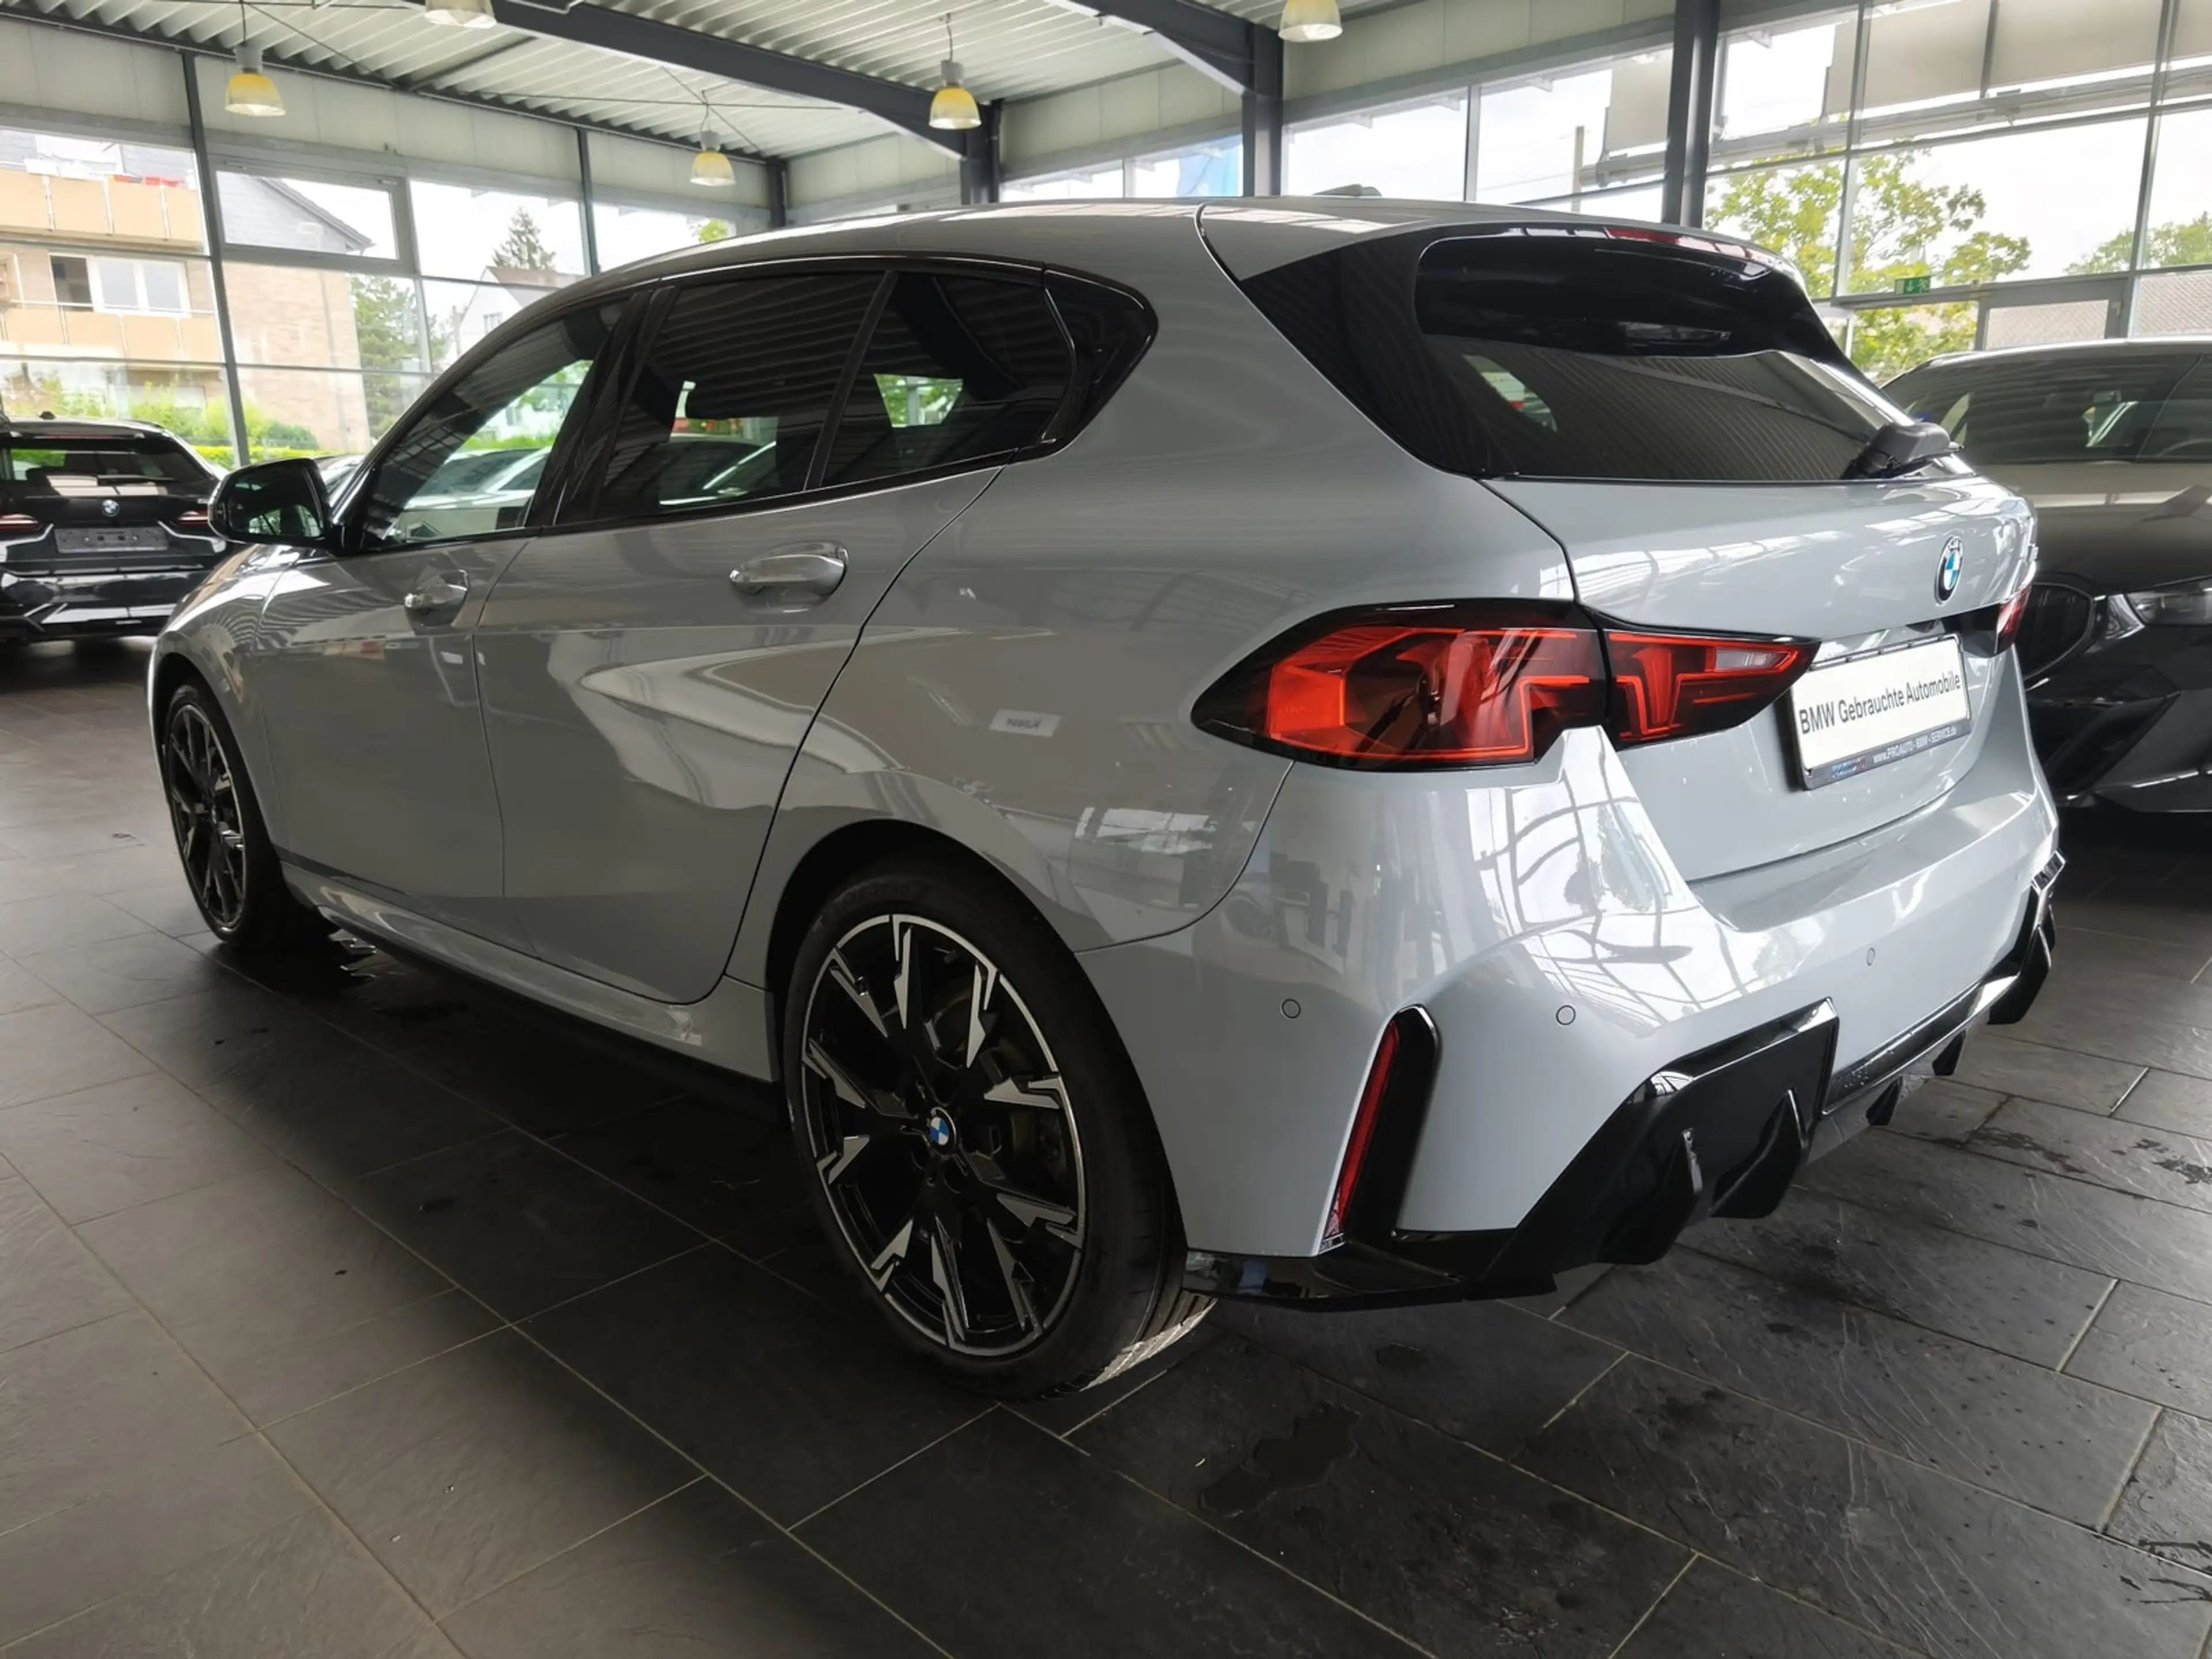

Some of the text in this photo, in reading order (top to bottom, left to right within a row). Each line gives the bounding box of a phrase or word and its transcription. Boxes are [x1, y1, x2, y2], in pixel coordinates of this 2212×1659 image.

[1799, 671, 1961, 734] BMW Gebrauchte Automobile
